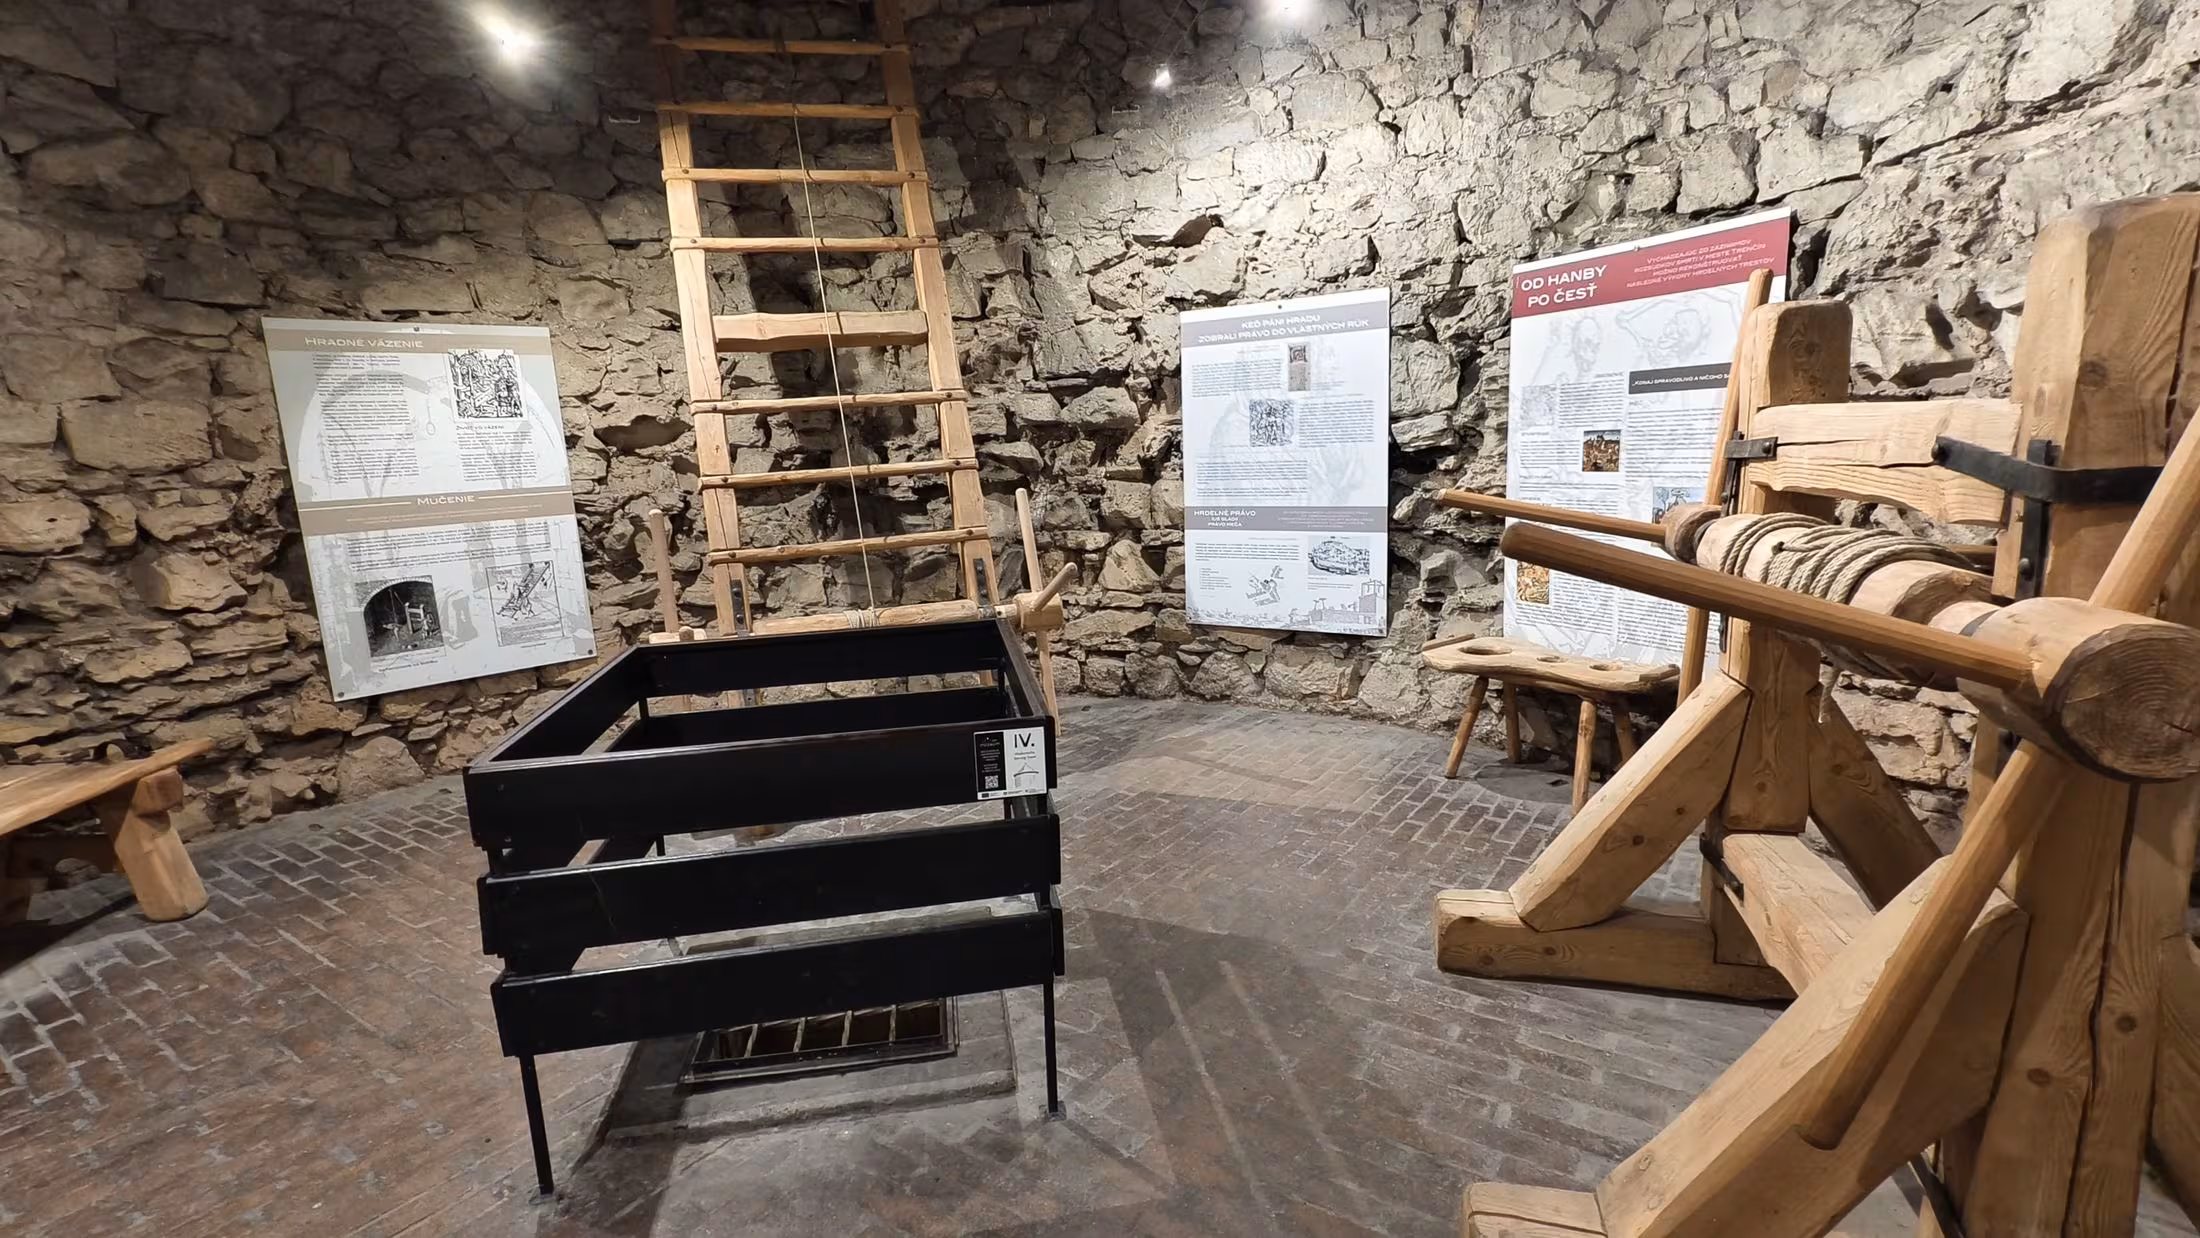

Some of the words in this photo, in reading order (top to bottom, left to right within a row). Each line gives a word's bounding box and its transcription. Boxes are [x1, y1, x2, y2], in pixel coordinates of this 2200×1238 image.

[1521, 277, 1544, 291] OD
[1548, 265, 1607, 286] HANBY
[1528, 294, 1550, 308] PO
[1553, 282, 1597, 303] ČESŤ
[1271, 327, 1286, 336] DO
[417, 495, 475, 505] MUČENIE
[1230, 508, 1256, 517] PRÁVO
[1014, 732, 1035, 748] IV.
